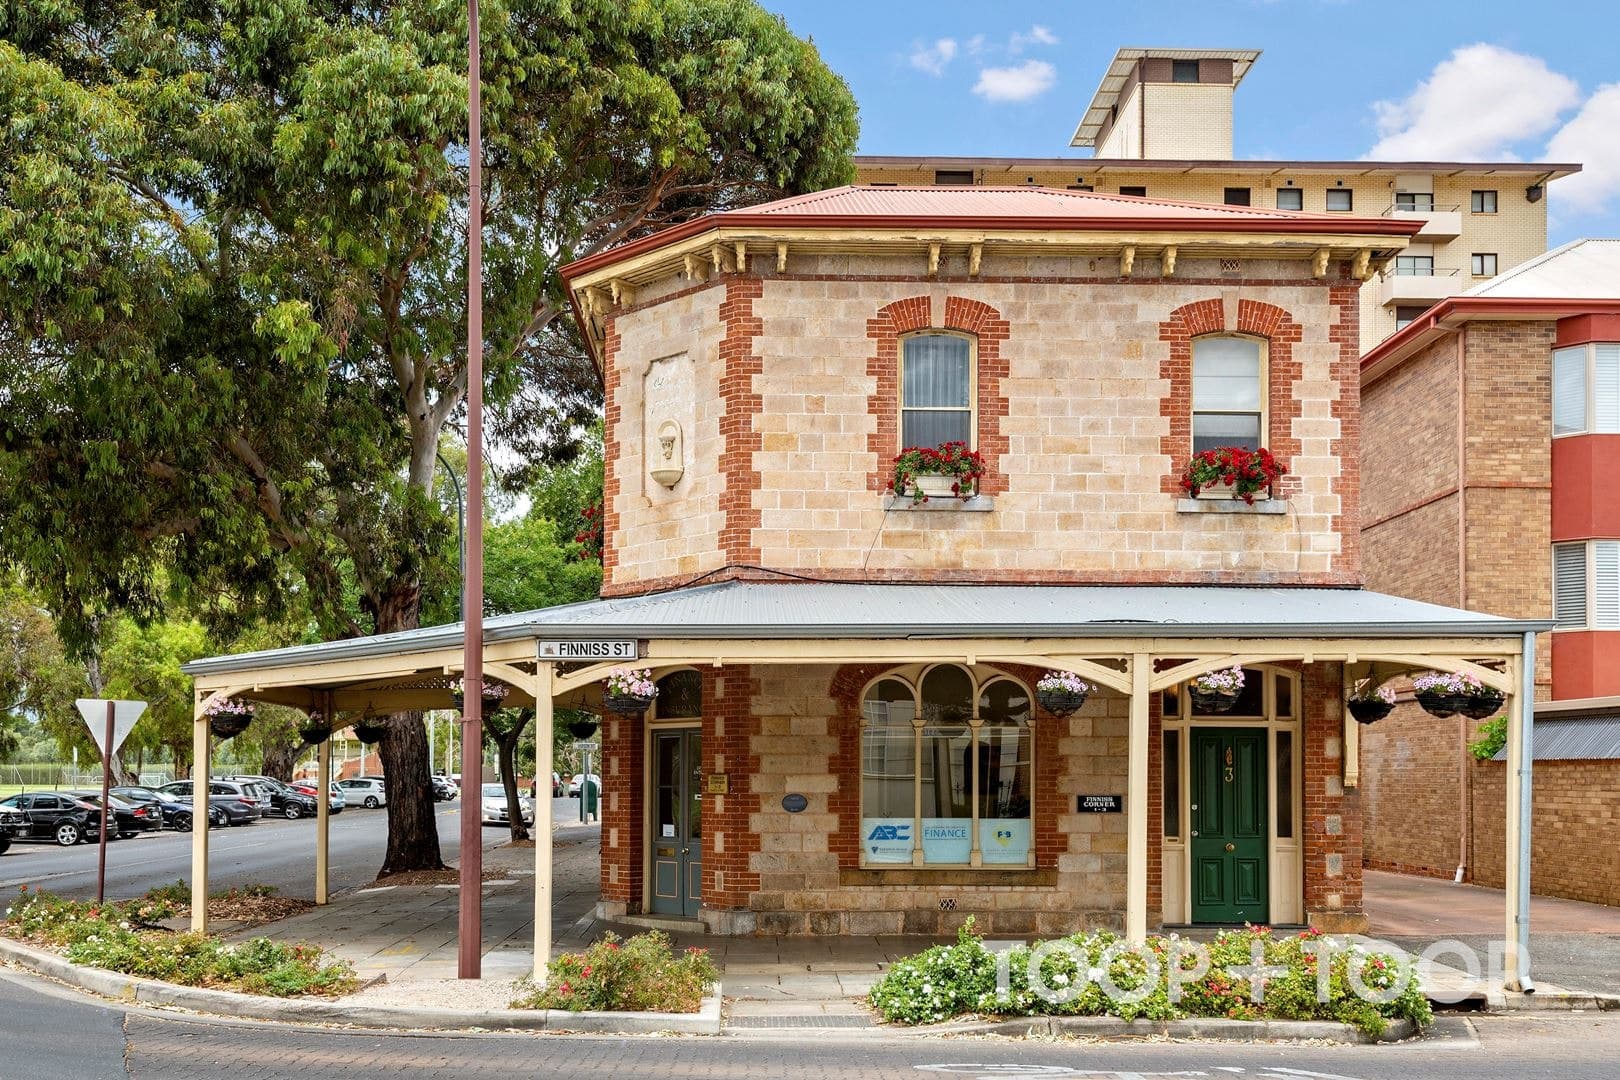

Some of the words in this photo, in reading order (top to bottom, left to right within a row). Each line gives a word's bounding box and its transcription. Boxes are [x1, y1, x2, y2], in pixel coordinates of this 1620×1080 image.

[559, 642, 610, 656] FINNISS
[613, 642, 631, 656] ST
[1225, 767, 1234, 782] 3
[868, 825, 911, 841] ABC
[924, 829, 967, 838] FINANCE
